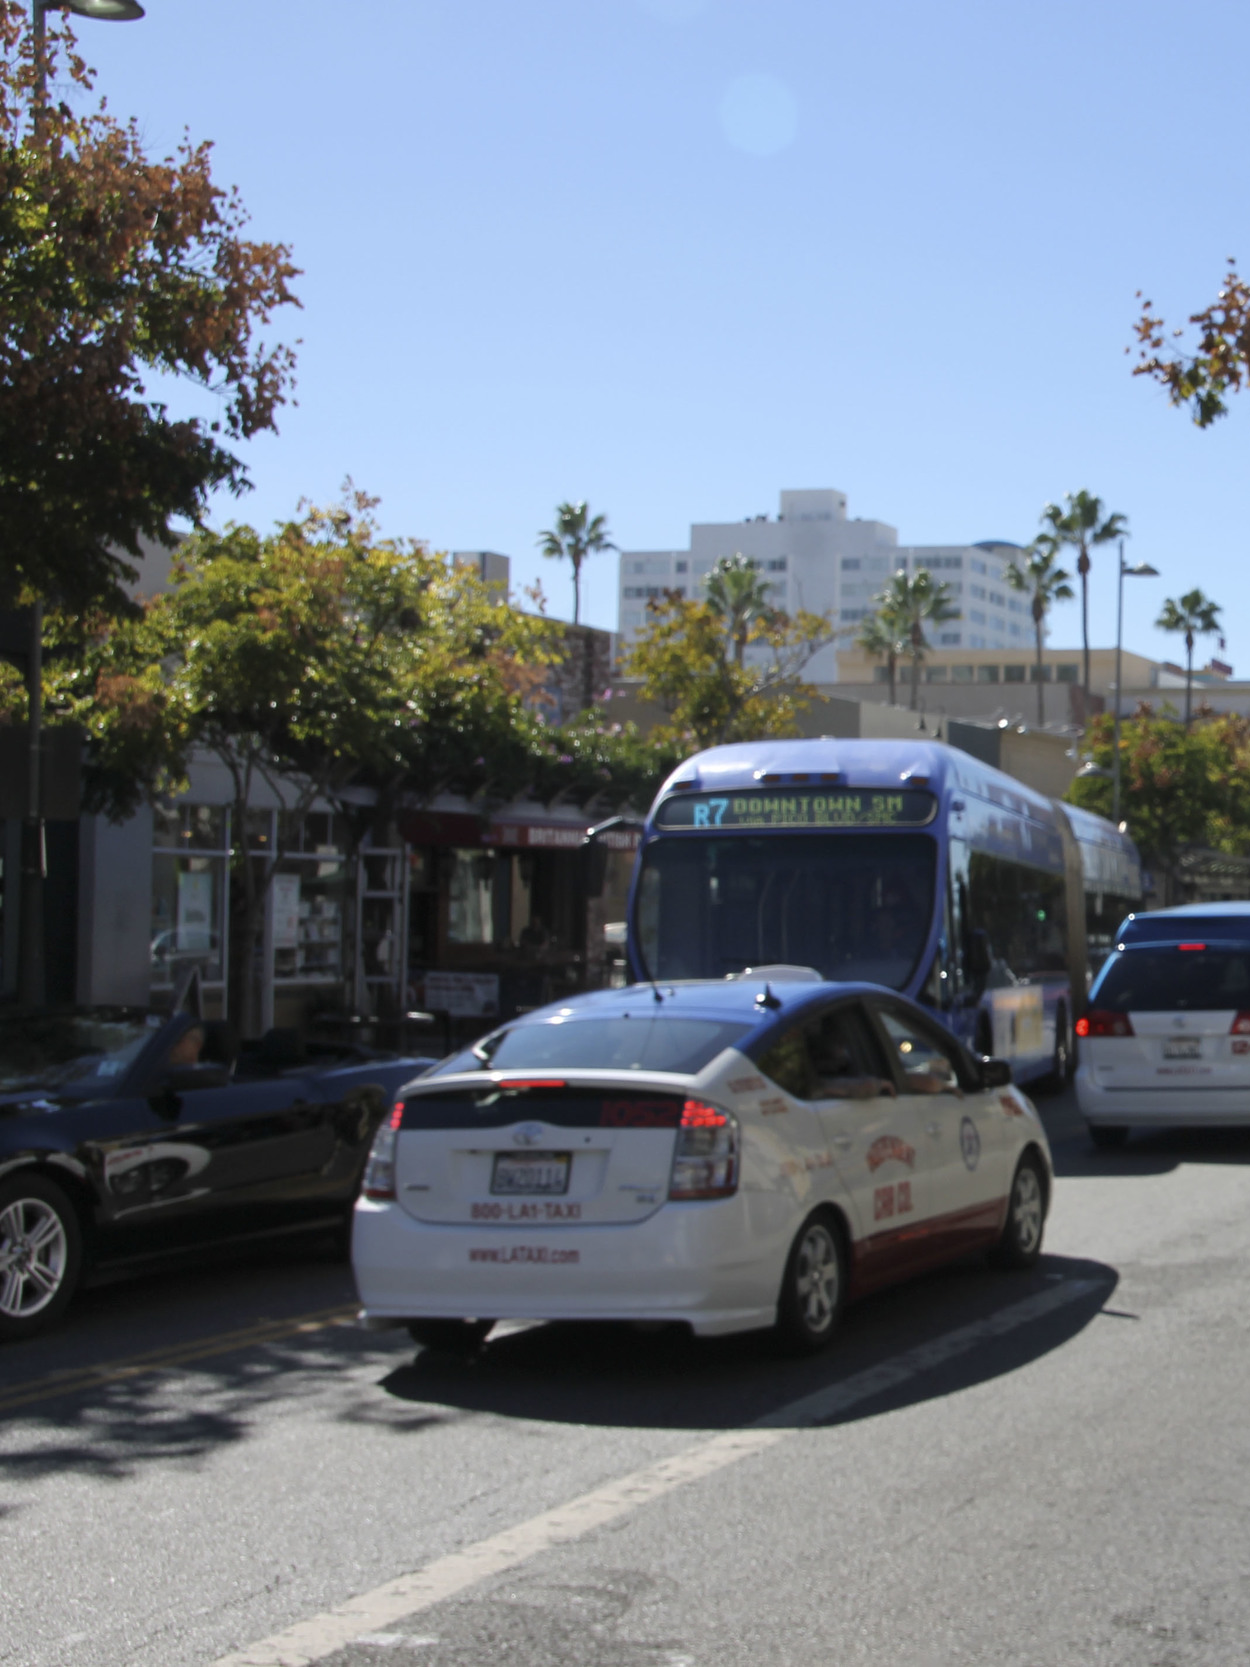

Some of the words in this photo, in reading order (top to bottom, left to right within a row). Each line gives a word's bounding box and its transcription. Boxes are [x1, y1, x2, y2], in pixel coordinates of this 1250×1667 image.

[693, 798, 728, 828] R7
[732, 796, 861, 814] DOWNTOWN
[872, 794, 904, 812] SM
[600, 1100, 679, 1127] 1052
